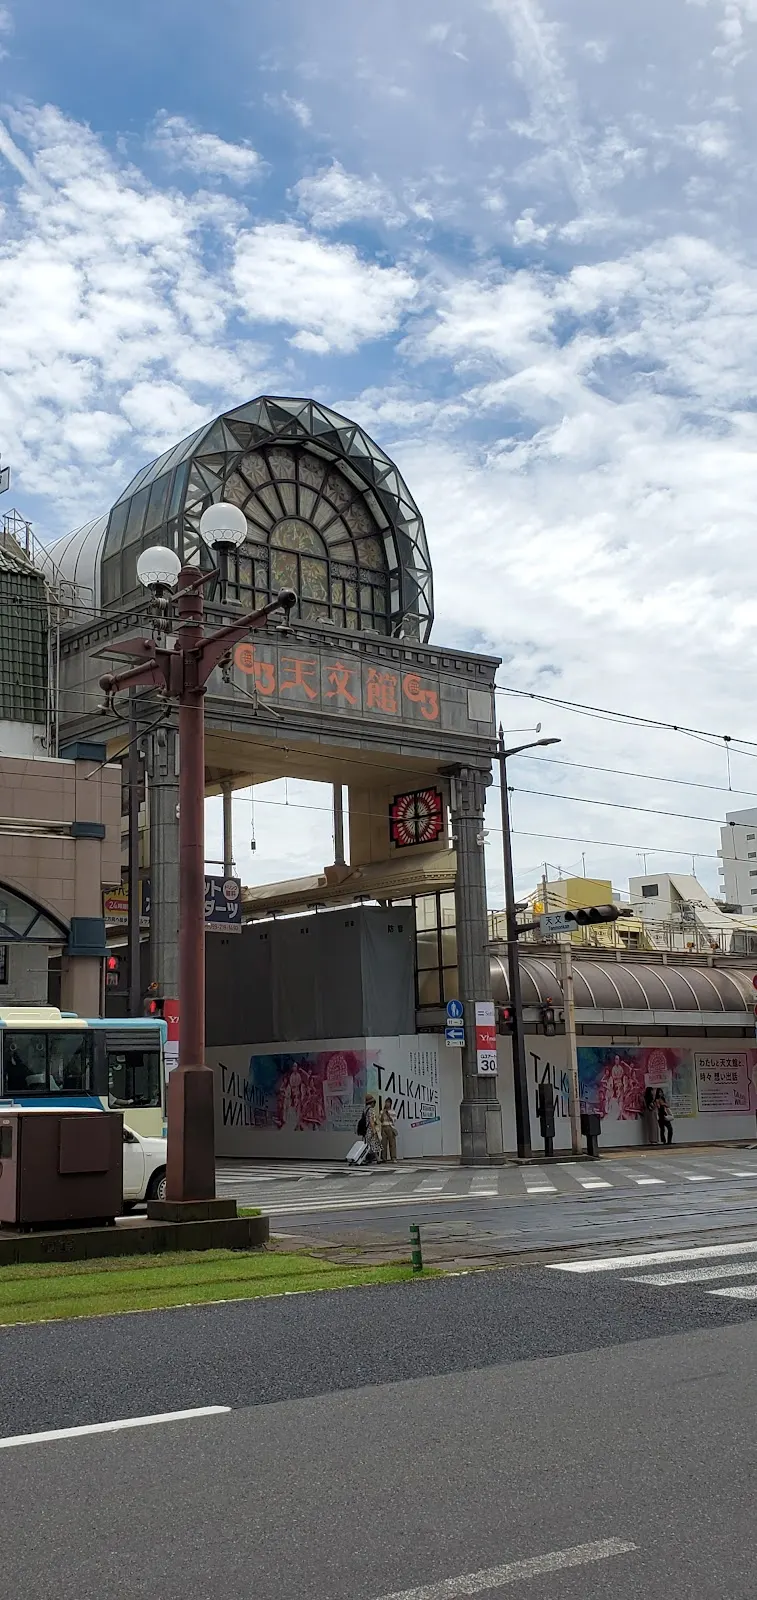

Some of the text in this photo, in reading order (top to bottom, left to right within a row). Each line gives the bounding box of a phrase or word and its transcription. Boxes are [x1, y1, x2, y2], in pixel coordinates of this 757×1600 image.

[279, 656, 398, 713] 天文館
[204, 899, 239, 919] ダーツ
[480, 1060, 496, 1071] 30
[218, 1062, 269, 1108] TALKATIVE
[372, 1063, 439, 1104] TALKATIVE
[222, 1097, 255, 1126] WALL
